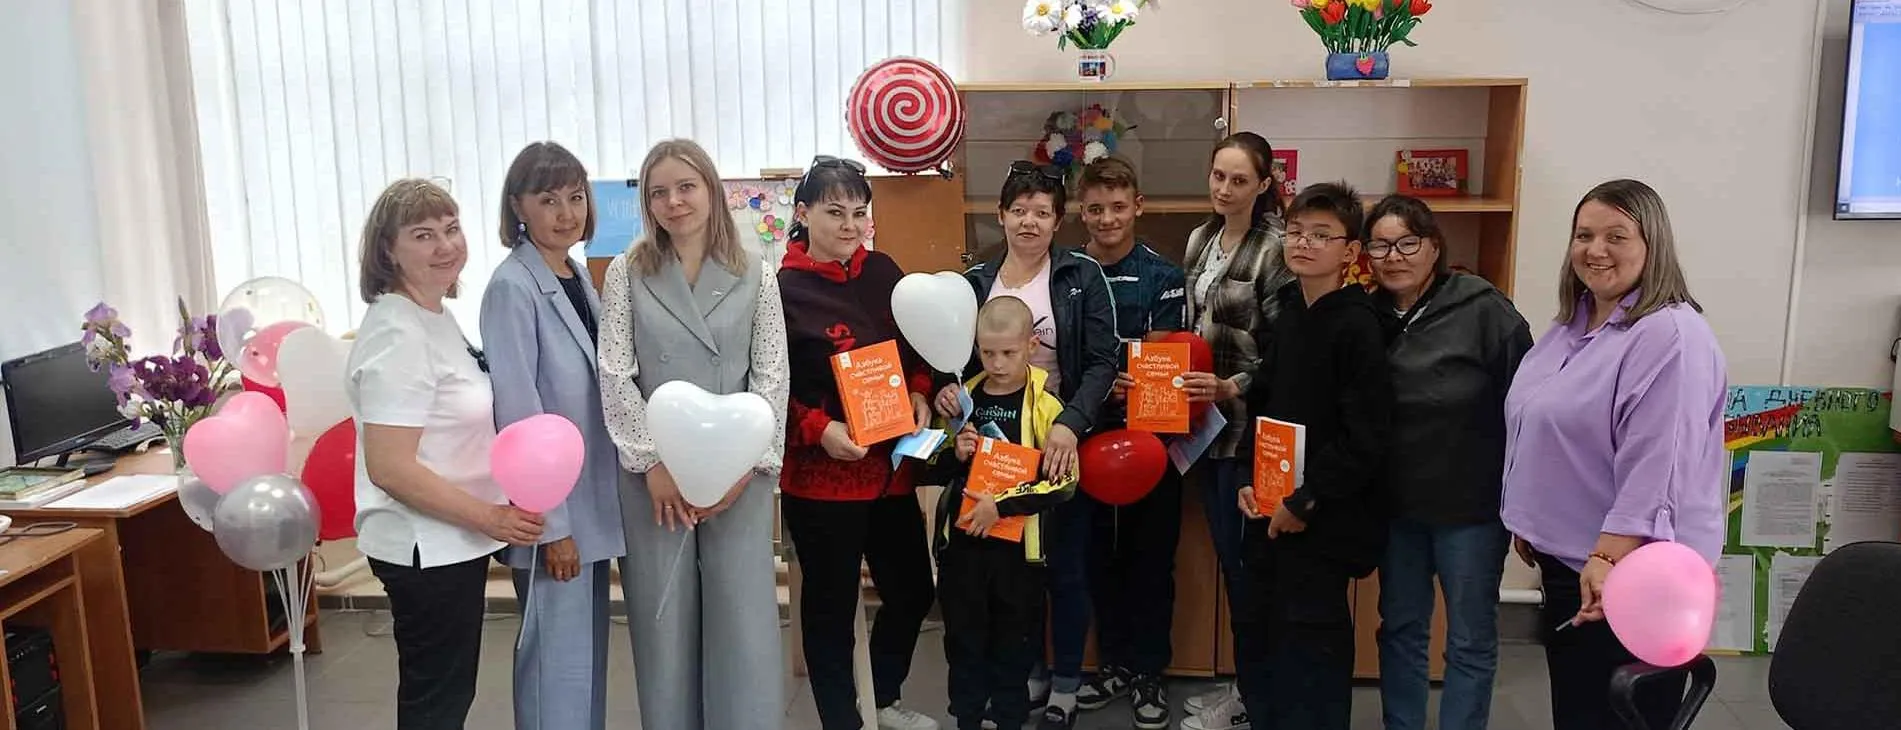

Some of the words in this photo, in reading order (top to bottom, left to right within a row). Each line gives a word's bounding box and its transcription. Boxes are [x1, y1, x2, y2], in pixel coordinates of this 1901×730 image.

[856, 357, 883, 369] Азбука
[1143, 353, 1171, 363] Азбука
[992, 452, 1021, 466] Азбука
